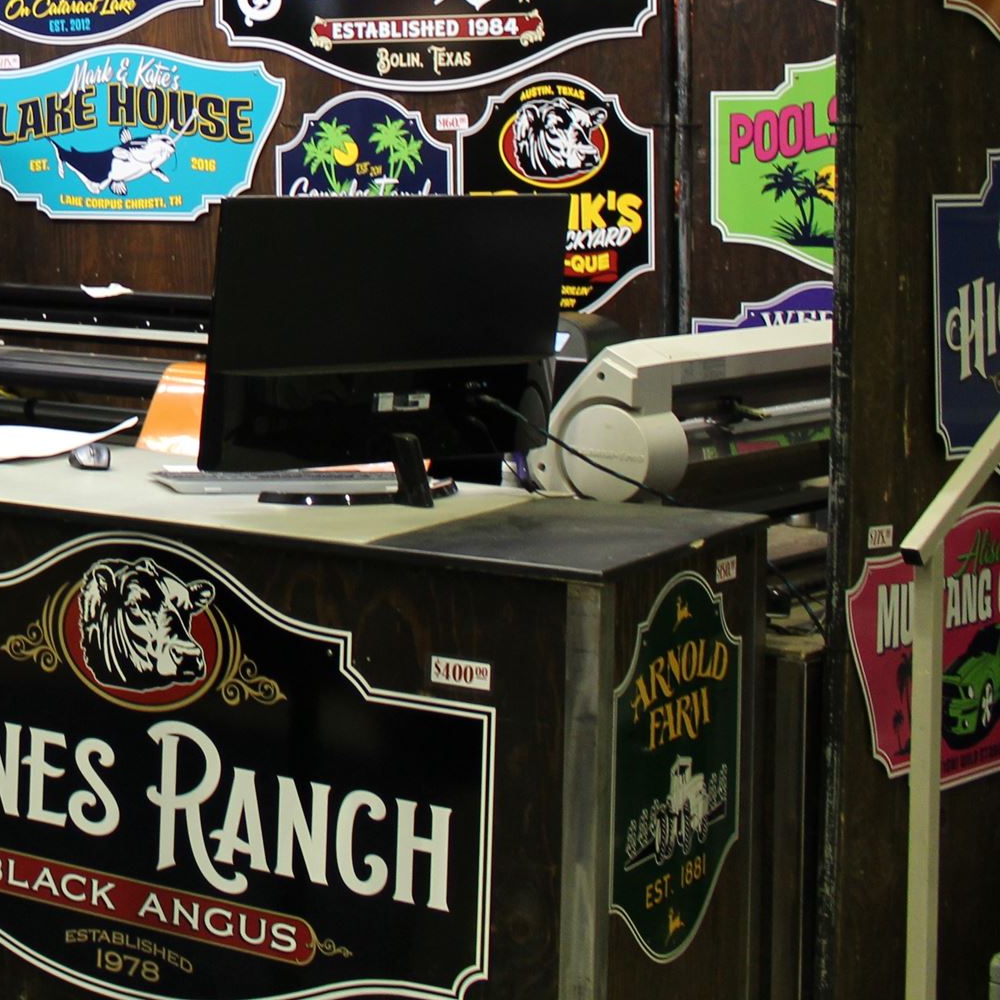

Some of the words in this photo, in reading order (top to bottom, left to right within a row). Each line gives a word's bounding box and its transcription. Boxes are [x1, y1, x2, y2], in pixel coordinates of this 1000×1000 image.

[49, 20, 68, 32] EST.
[70, 18, 91, 31] 2012
[331, 17, 459, 40] ESTABLISHED
[467, 16, 520, 37] 1984
[61, 60, 114, 99] Mark
[116, 57, 131, 88] &
[136, 55, 181, 91] Katie's
[427, 45, 472, 74] TEXAS
[107, 83, 254, 145] HOUSE
[556, 84, 586, 101] TEXAS
[29, 158, 51, 173] EST.
[190, 157, 217, 172] 2016
[630, 639, 729, 723] ARNOLD
[146, 720, 453, 913] RANCH
[645, 872, 675, 910] EST.
[679, 853, 708, 891] 1881
[137, 889, 298, 954] ANGUS
[64, 927, 194, 975] ESTABLISHED
[94, 947, 161, 983] 1978
